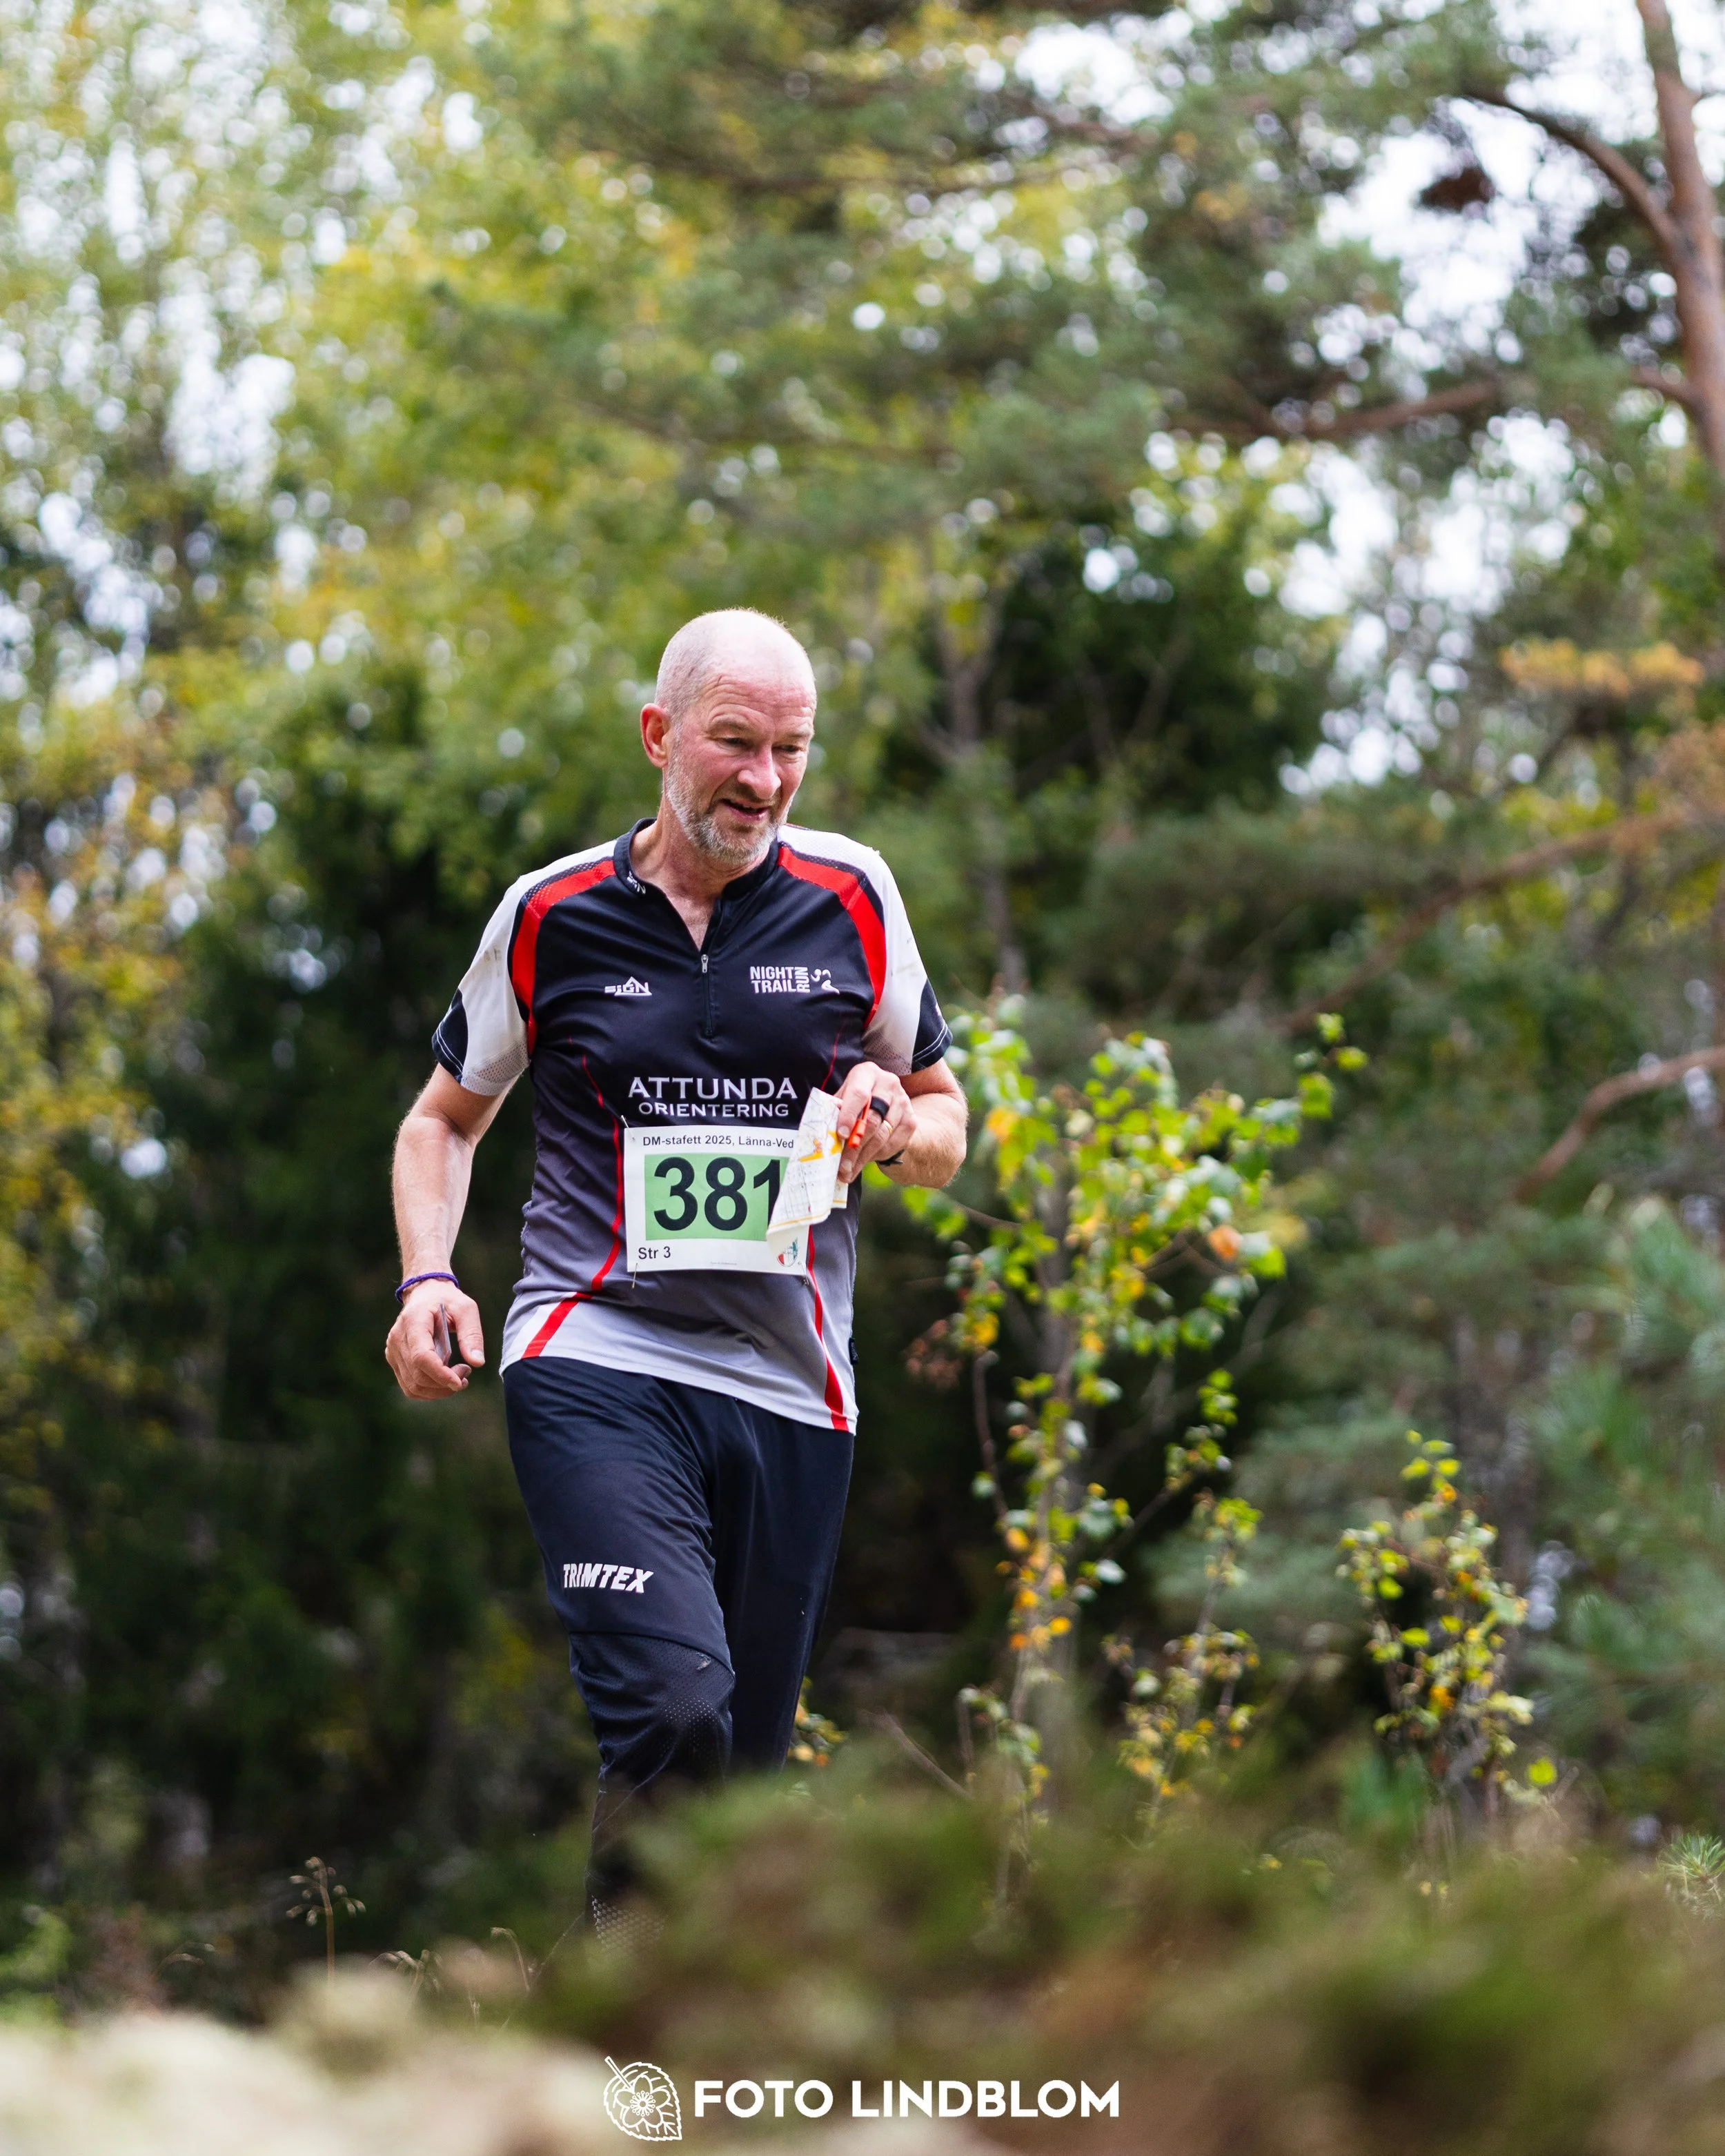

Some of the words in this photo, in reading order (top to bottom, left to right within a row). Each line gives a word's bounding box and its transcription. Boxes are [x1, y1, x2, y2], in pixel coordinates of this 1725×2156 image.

[749, 966, 793, 980] NIGHT
[794, 967, 810, 993] RUN
[751, 980, 797, 993] TRAIL
[628, 1076, 798, 1100] ATTUNDA
[638, 1102, 789, 1117] ORIENTERING
[642, 1135, 702, 1146] DM-stafett
[704, 1135, 735, 1147] 2025,
[653, 1156, 781, 1232] 381
[638, 1247, 659, 1260] Str
[663, 1246, 671, 1258] 3
[563, 1563, 654, 1594] TRIMTEX
